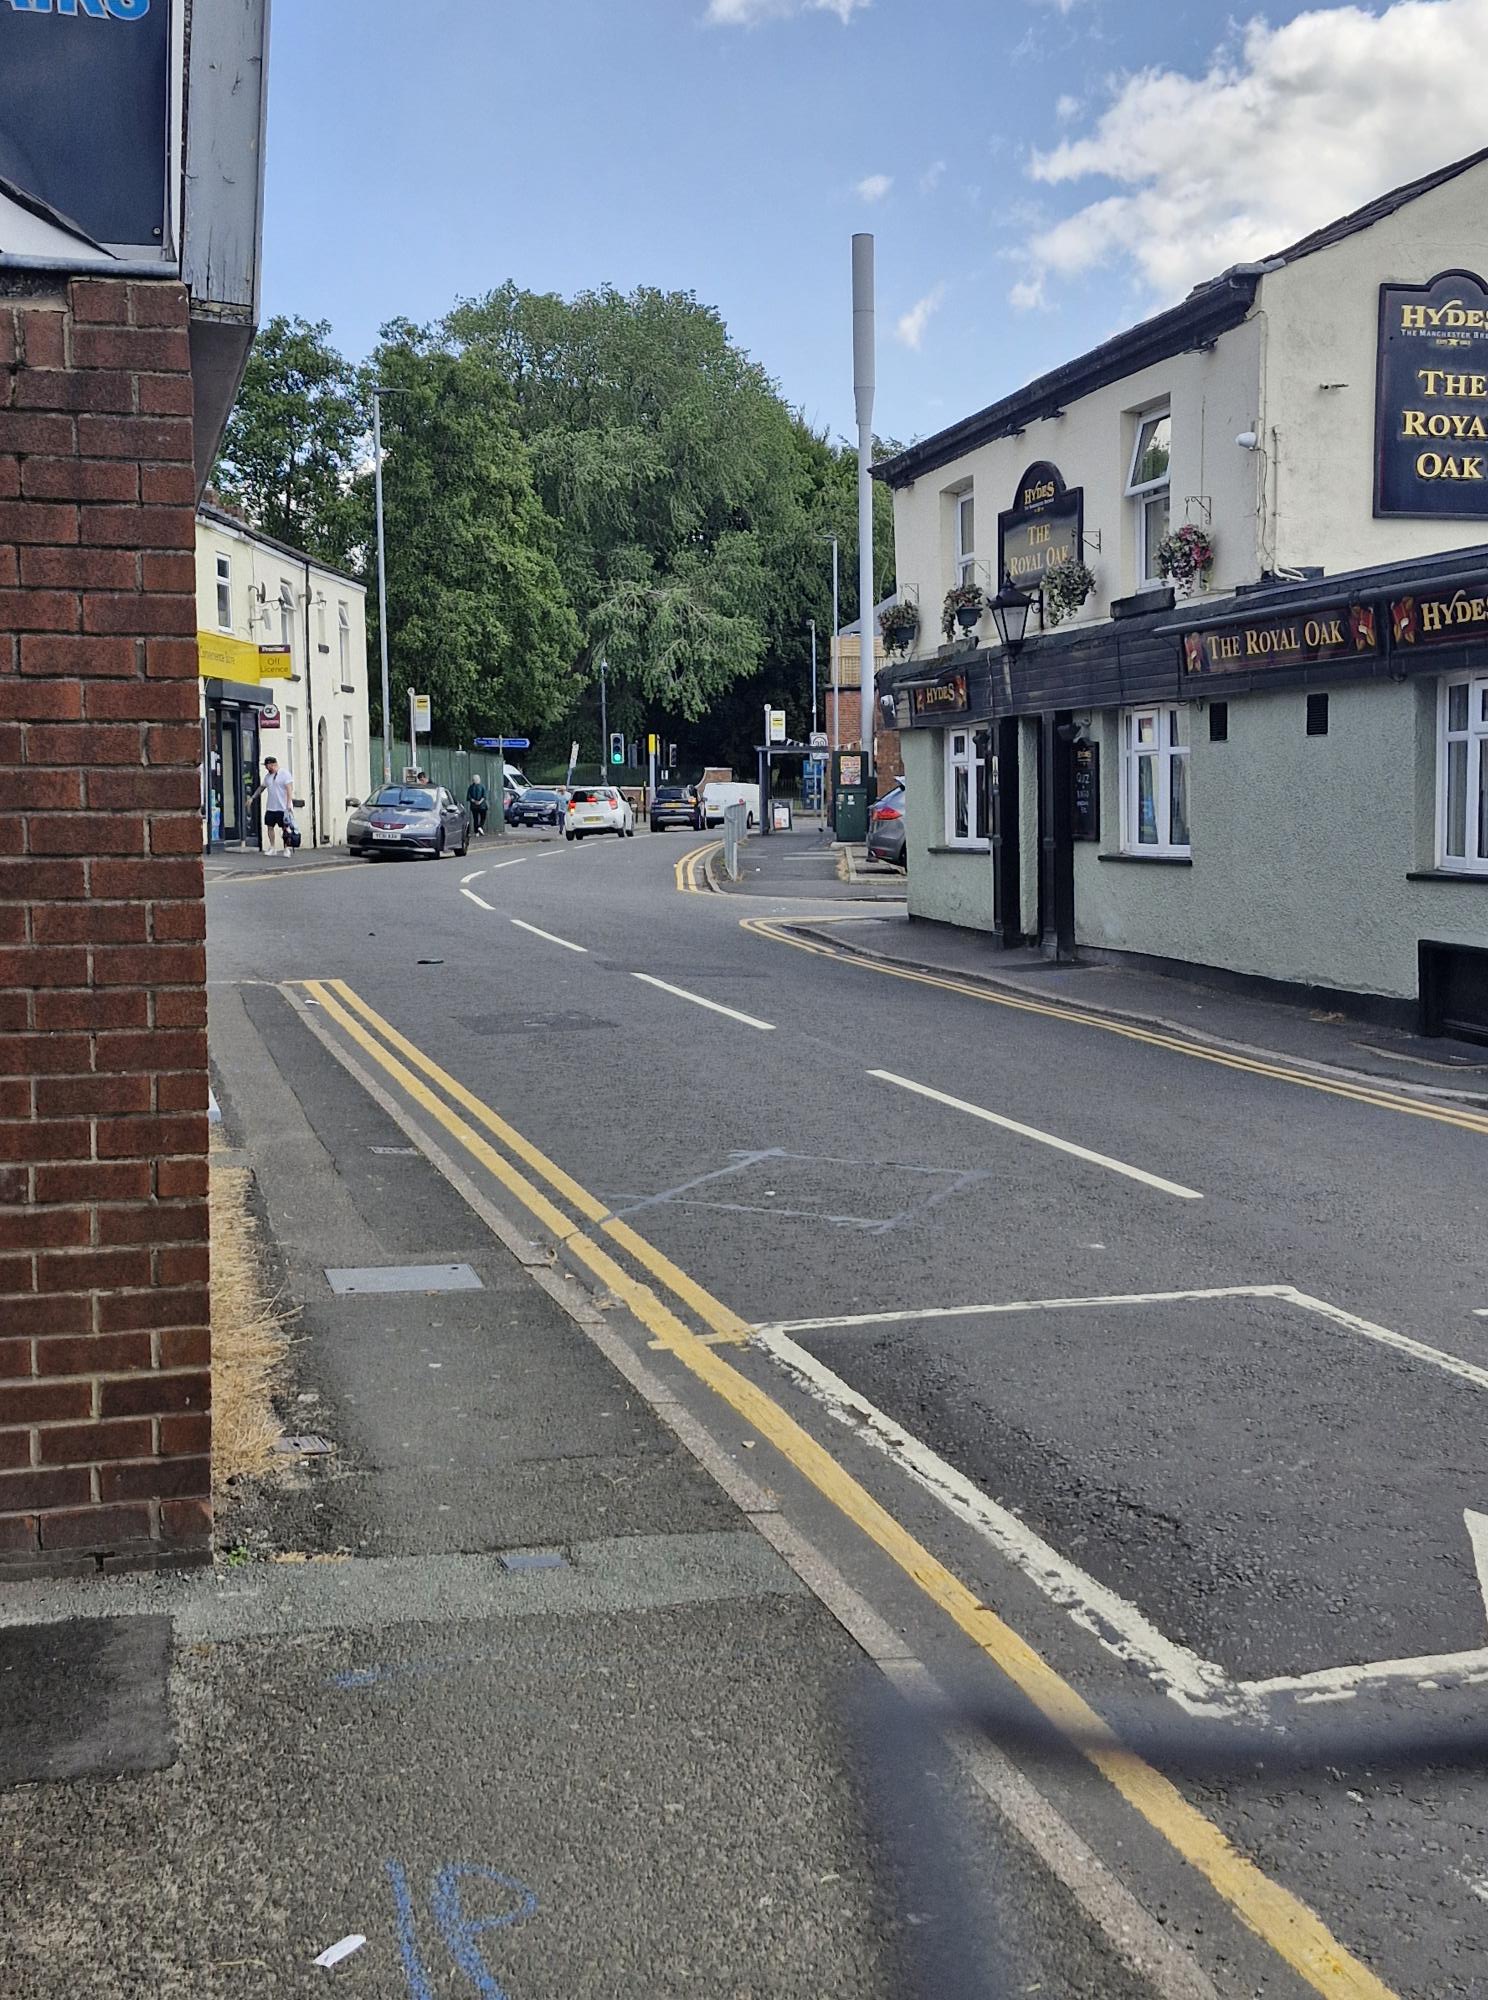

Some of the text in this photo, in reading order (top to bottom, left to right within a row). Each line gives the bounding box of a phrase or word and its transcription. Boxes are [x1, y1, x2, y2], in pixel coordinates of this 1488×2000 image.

[1401, 299, 1488, 330] HYDE
[1401, 329, 1417, 337] THE
[1420, 329, 1471, 339] MANCHESTER
[1418, 369, 1487, 397] THE
[1416, 452, 1483, 479] OAK
[1024, 480, 1055, 505] HYDES
[1027, 523, 1051, 546] THE
[1010, 552, 1044, 577] ROYAL
[1420, 589, 1488, 632] HYDE
[1207, 620, 1345, 660] THE ROYAL OAK
[926, 683, 955, 704] HYDES
